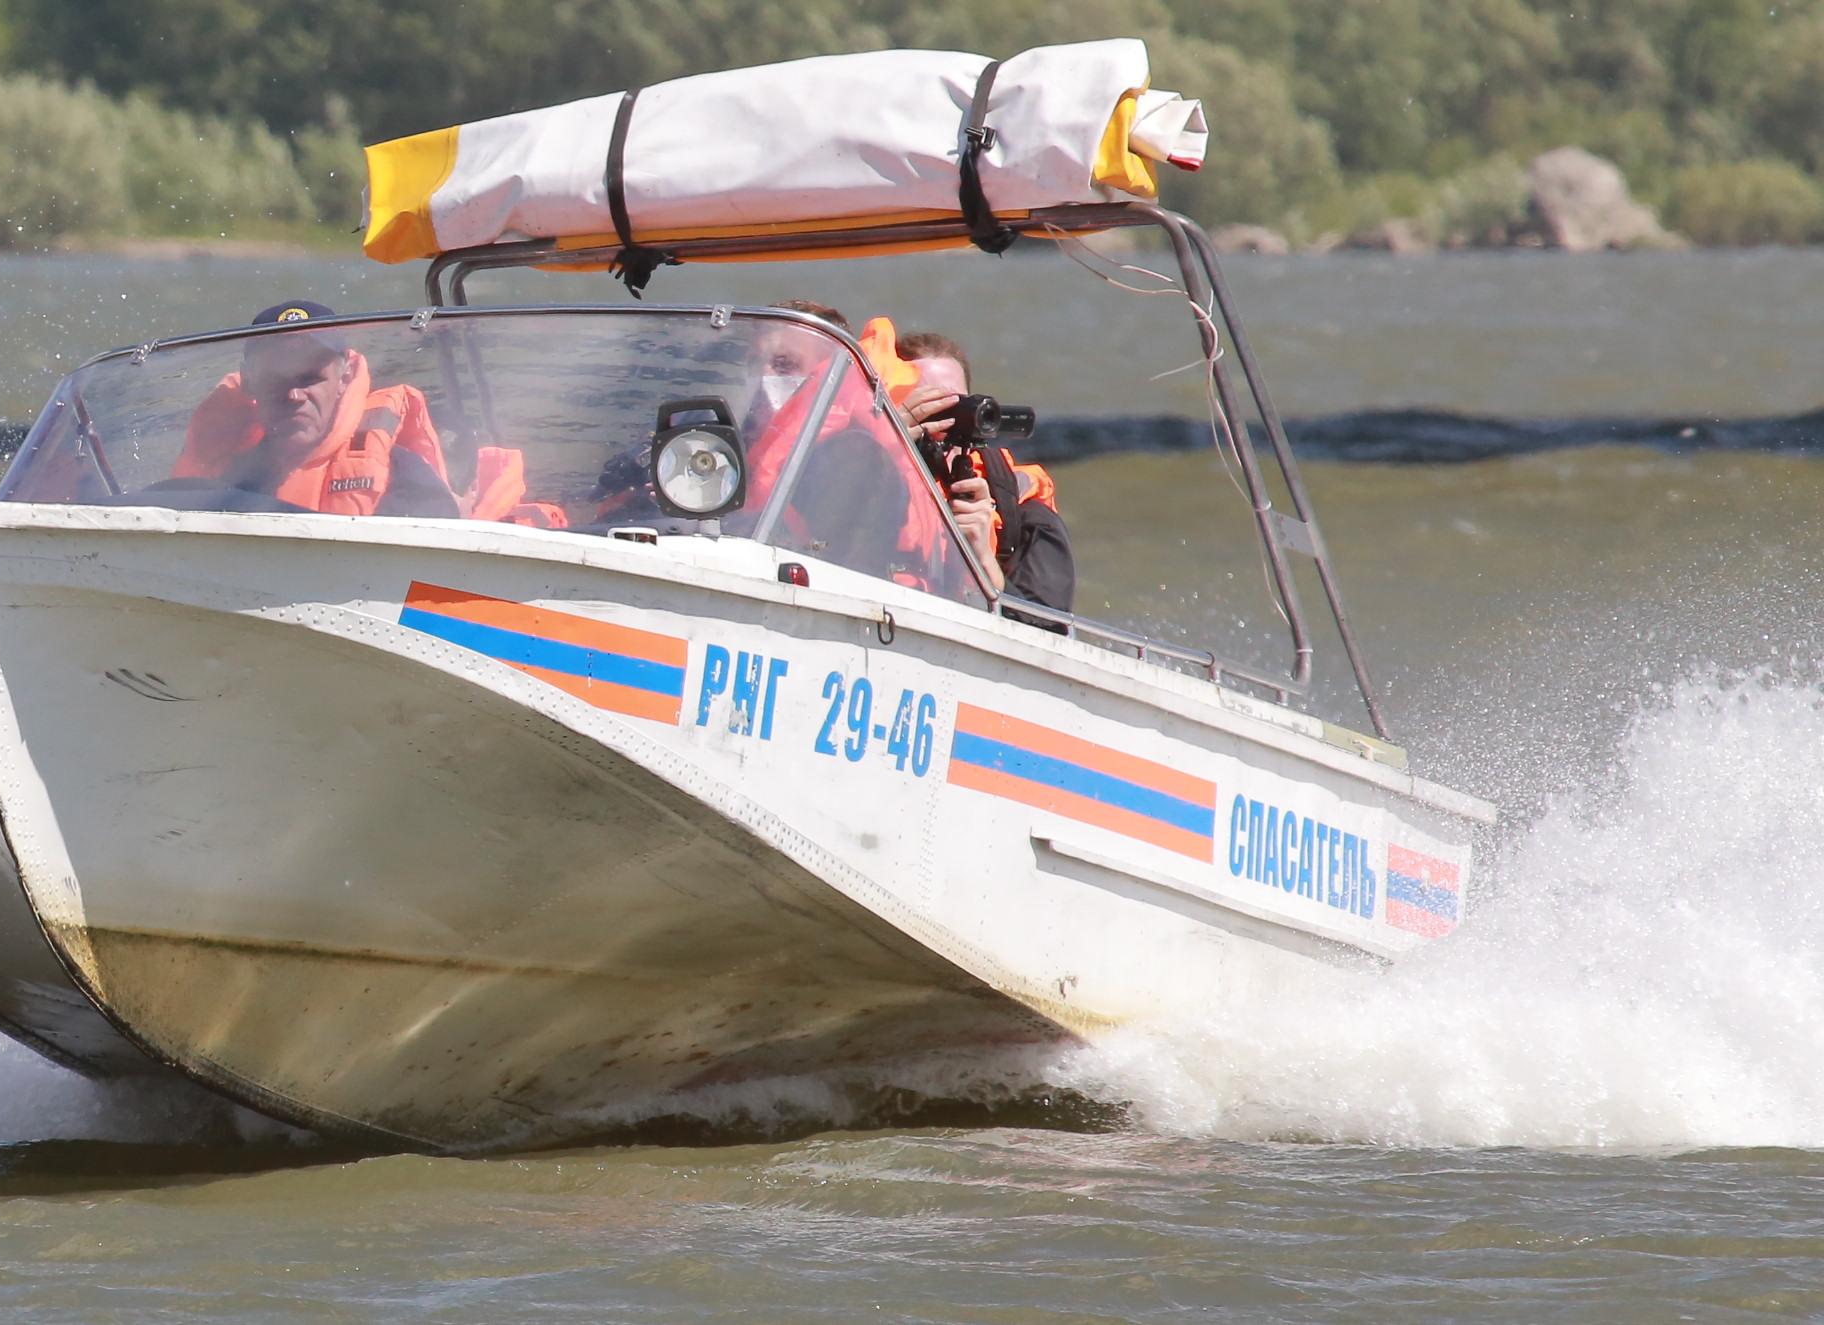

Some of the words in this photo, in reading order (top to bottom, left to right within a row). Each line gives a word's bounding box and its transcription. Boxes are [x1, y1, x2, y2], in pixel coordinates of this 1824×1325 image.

[696, 643, 789, 741] РНГ
[814, 670, 936, 777] 29-46
[1229, 793, 1376, 920] СПАСАТЕЛЬ
